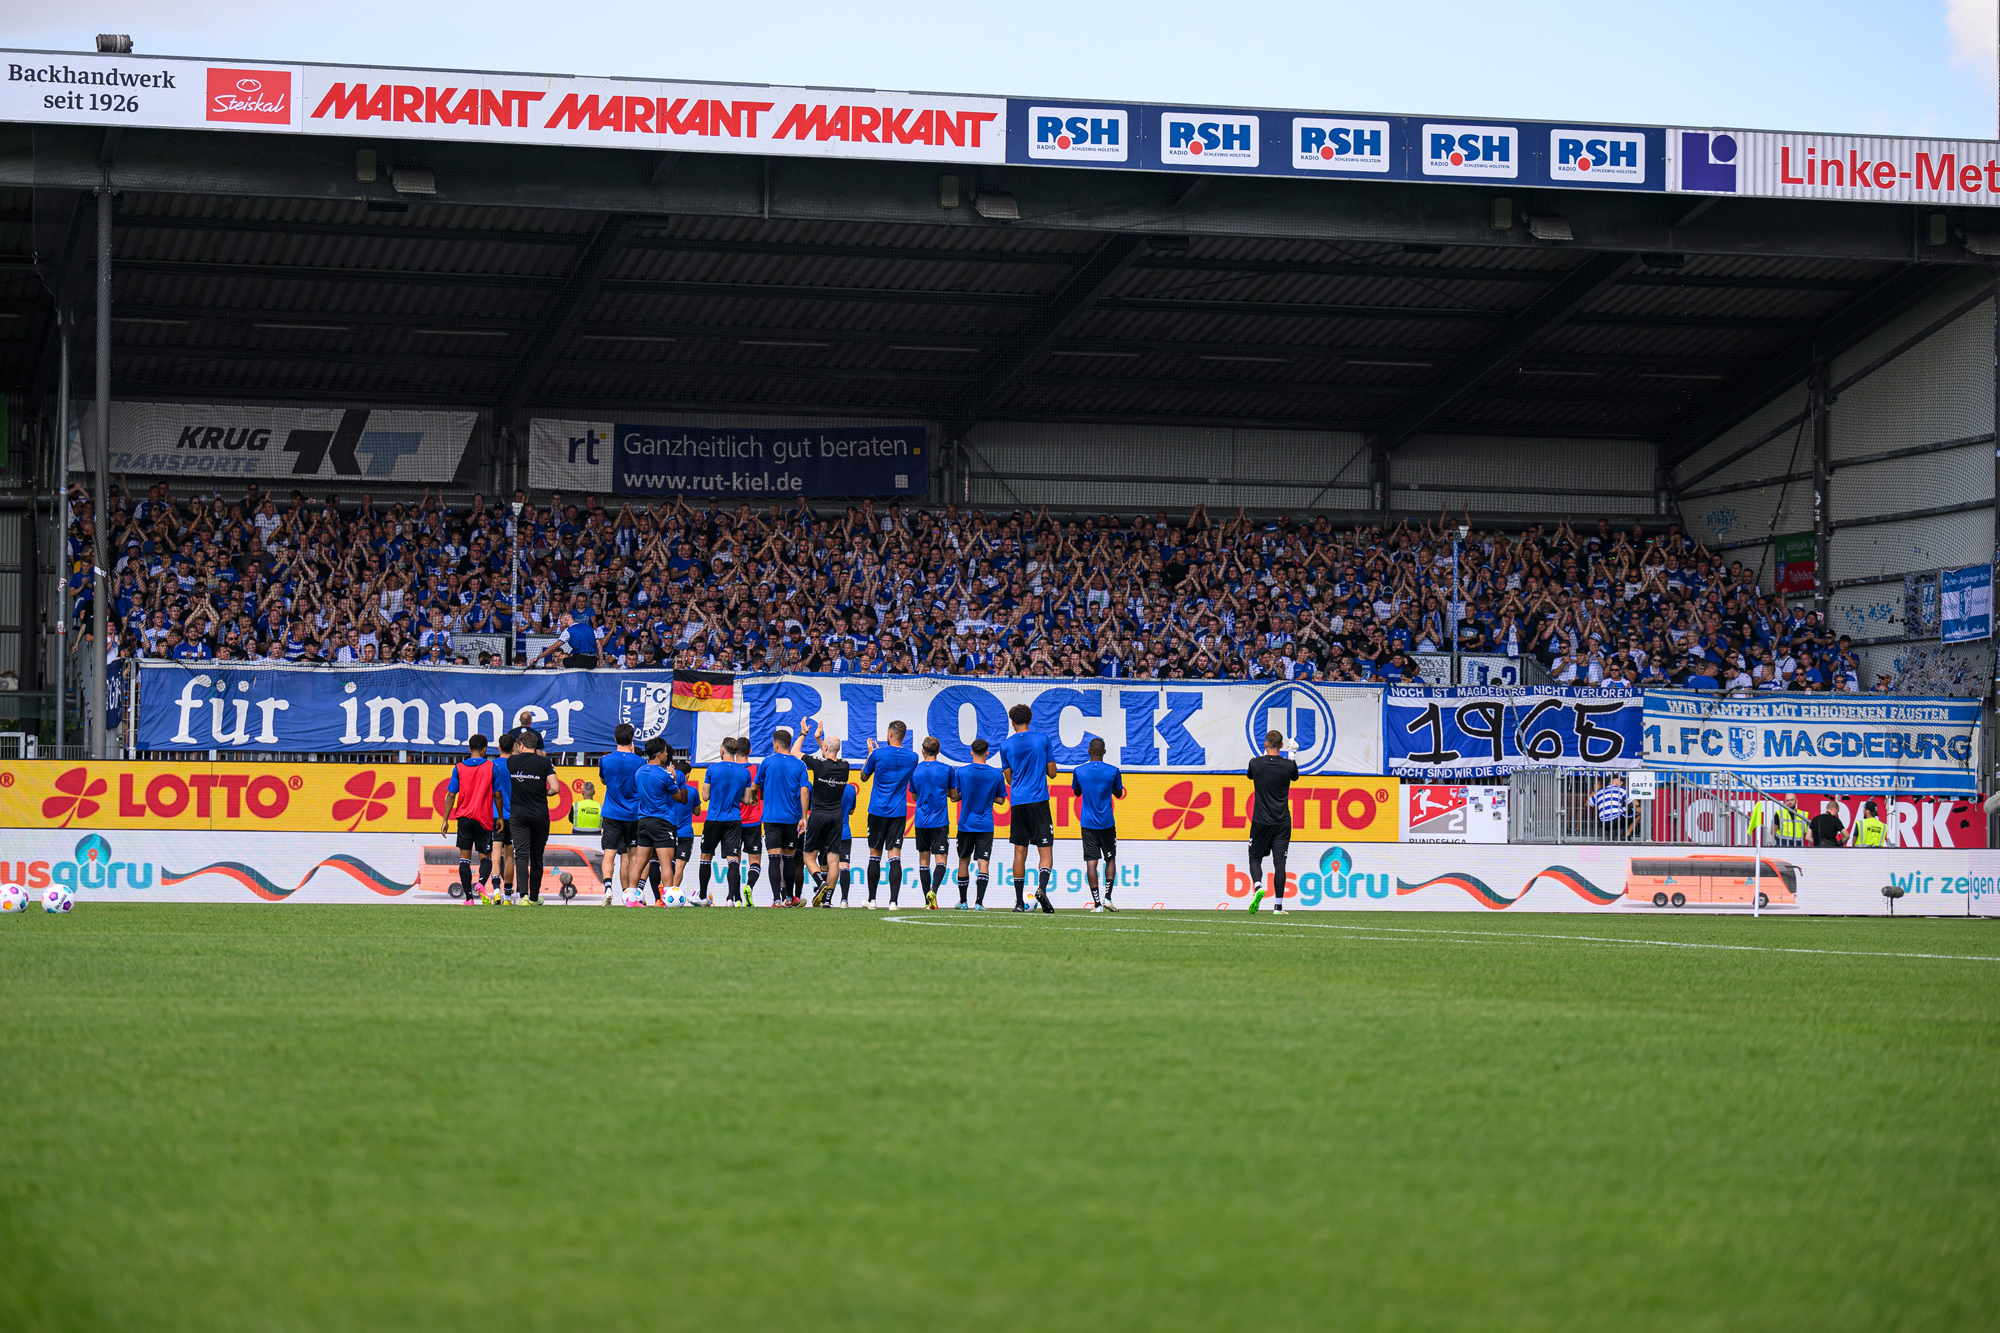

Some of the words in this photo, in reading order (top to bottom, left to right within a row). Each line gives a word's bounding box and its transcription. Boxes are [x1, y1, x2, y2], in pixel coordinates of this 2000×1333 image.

[8, 63, 176, 89] Backhandwerk
[43, 91, 84, 110] seit
[89, 93, 139, 113] 1926
[212, 92, 285, 114] Steiskal
[310, 82, 546, 128] MARKANT
[544, 93, 775, 138] MARKANT
[772, 103, 998, 148] MARKANT
[1036, 116, 1120, 146] RSH
[1169, 121, 1251, 151] RSH
[1300, 127, 1382, 156] RSH
[1430, 133, 1510, 162] RSH
[1558, 138, 1638, 168] RSH
[177, 426, 272, 452] KRUG
[567, 429, 601, 465] rt
[623, 433, 763, 458] Ganzheitlich
[772, 437, 812, 464] gut
[109, 452, 261, 474] TRANSPORTE
[623, 471, 803, 492] www.rut-kiel.de
[624, 686, 667, 704] 1.FC
[1391, 687, 1424, 698] NOCH
[1432, 687, 1449, 698] IST
[1457, 686, 1526, 697] MAGDEBURG
[1533, 685, 1568, 697] NICHT
[1573, 687, 1633, 698] VERLOREN
[170, 674, 290, 744] für
[339, 681, 584, 746] immer
[622, 705, 667, 739] MADEBURG
[743, 681, 1205, 767] BLOCK
[1666, 700, 1697, 715] WIR
[1772, 704, 1798, 717] MIT
[1800, 705, 1887, 719] ERHOBENEN
[1889, 704, 1949, 720] FÄUSTEN
[1407, 699, 1624, 764] 1965
[1644, 724, 1723, 757] 1.FC
[1764, 729, 1973, 761] MAGDEBURG
[1391, 767, 1423, 777] NOCH
[1427, 767, 1453, 778] SIND
[1454, 767, 1473, 777] WIR
[1476, 766, 1493, 776] DIE
[1741, 774, 1797, 788] UNSERE
[1799, 774, 1915, 788] FESTUNGSSTADT
[1448, 810, 1464, 831] 2
[1890, 870, 1934, 894] Wir
[1940, 870, 1994, 899] zeigen
